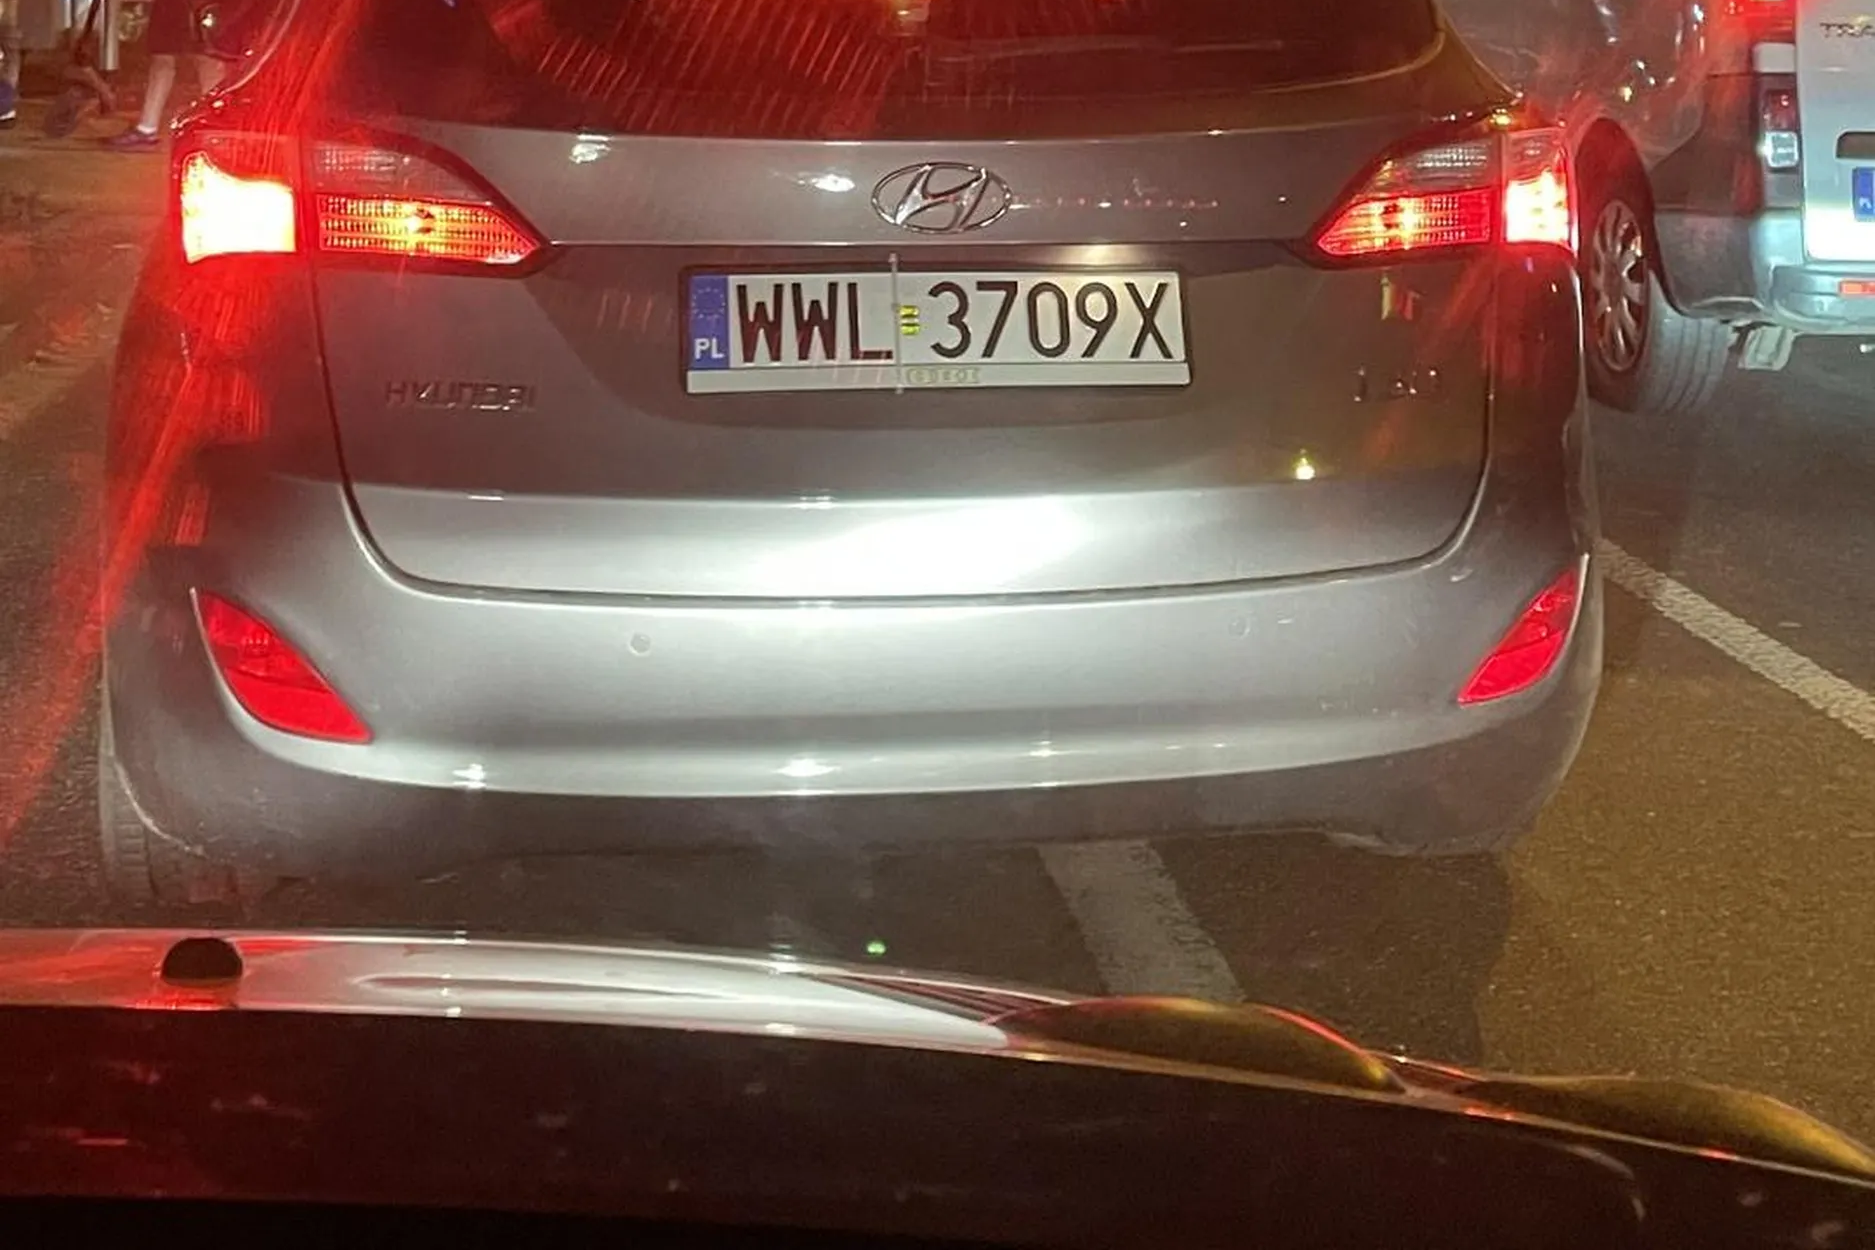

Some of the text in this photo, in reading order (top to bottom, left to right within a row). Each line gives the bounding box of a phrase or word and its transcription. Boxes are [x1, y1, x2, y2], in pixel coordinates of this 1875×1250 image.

[694, 338, 725, 358] PL
[736, 281, 1173, 364] WWL 3709X
